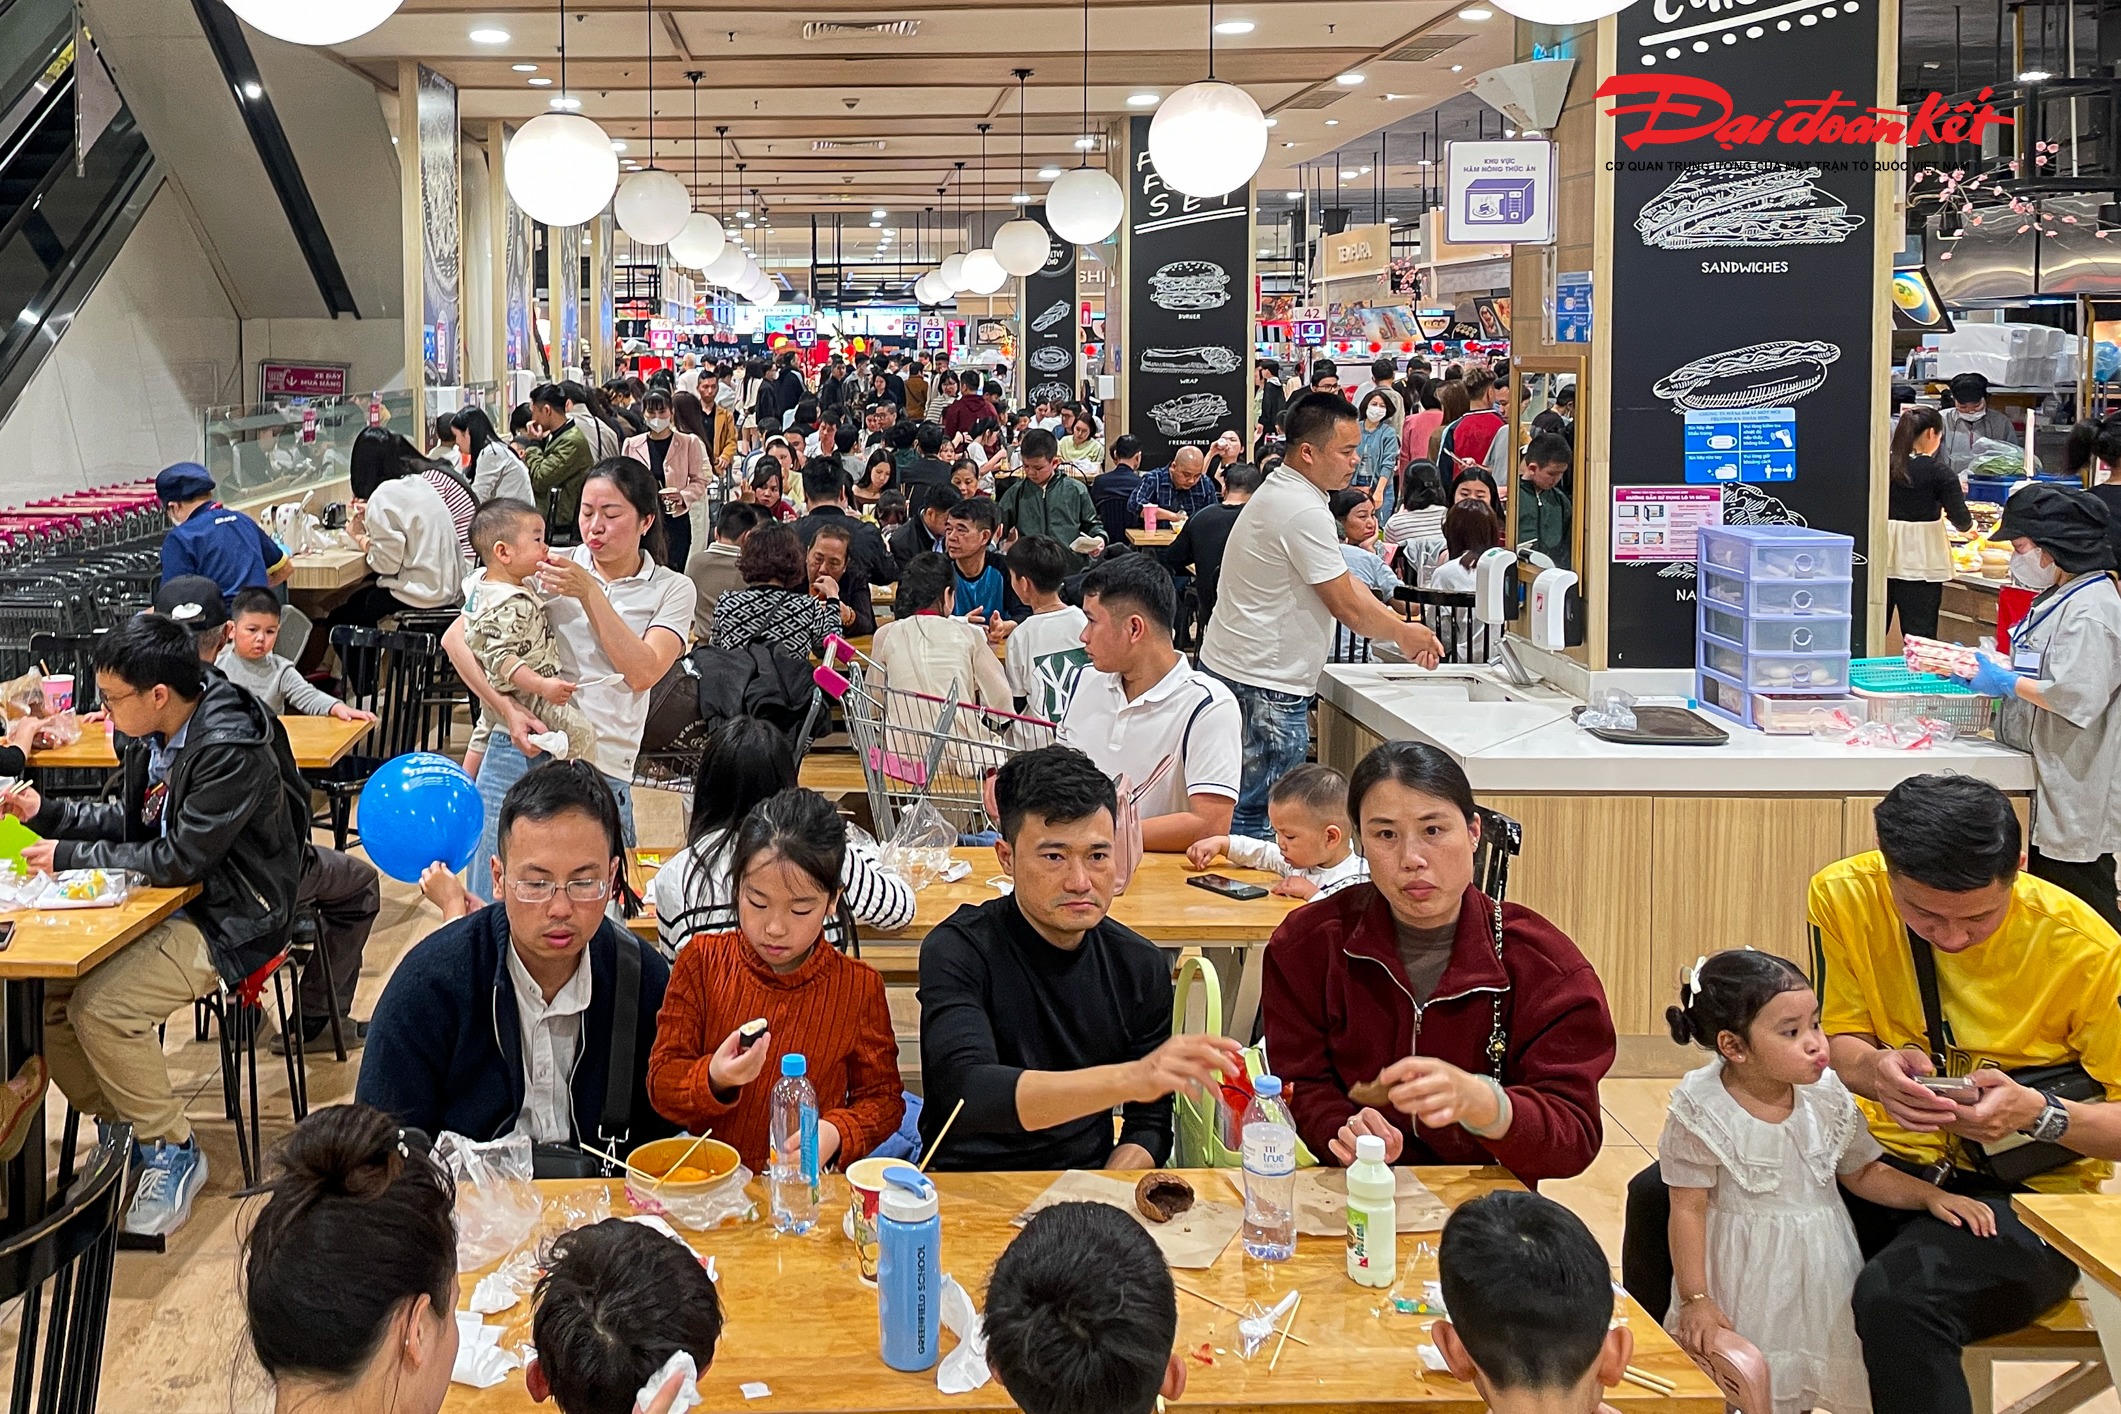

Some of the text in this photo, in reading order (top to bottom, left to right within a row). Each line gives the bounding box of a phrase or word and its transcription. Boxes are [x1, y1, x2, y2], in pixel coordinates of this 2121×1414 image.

[1701, 260, 1789, 274] SANDWICHES
[1304, 308, 1320, 318] 42
[799, 319, 811, 327] 44
[927, 318, 940, 327] 43
[1676, 590, 1697, 601] NA
[1263, 1153, 1285, 1163] true
[917, 1244, 926, 1355] GREENFIELD SCHOOL
